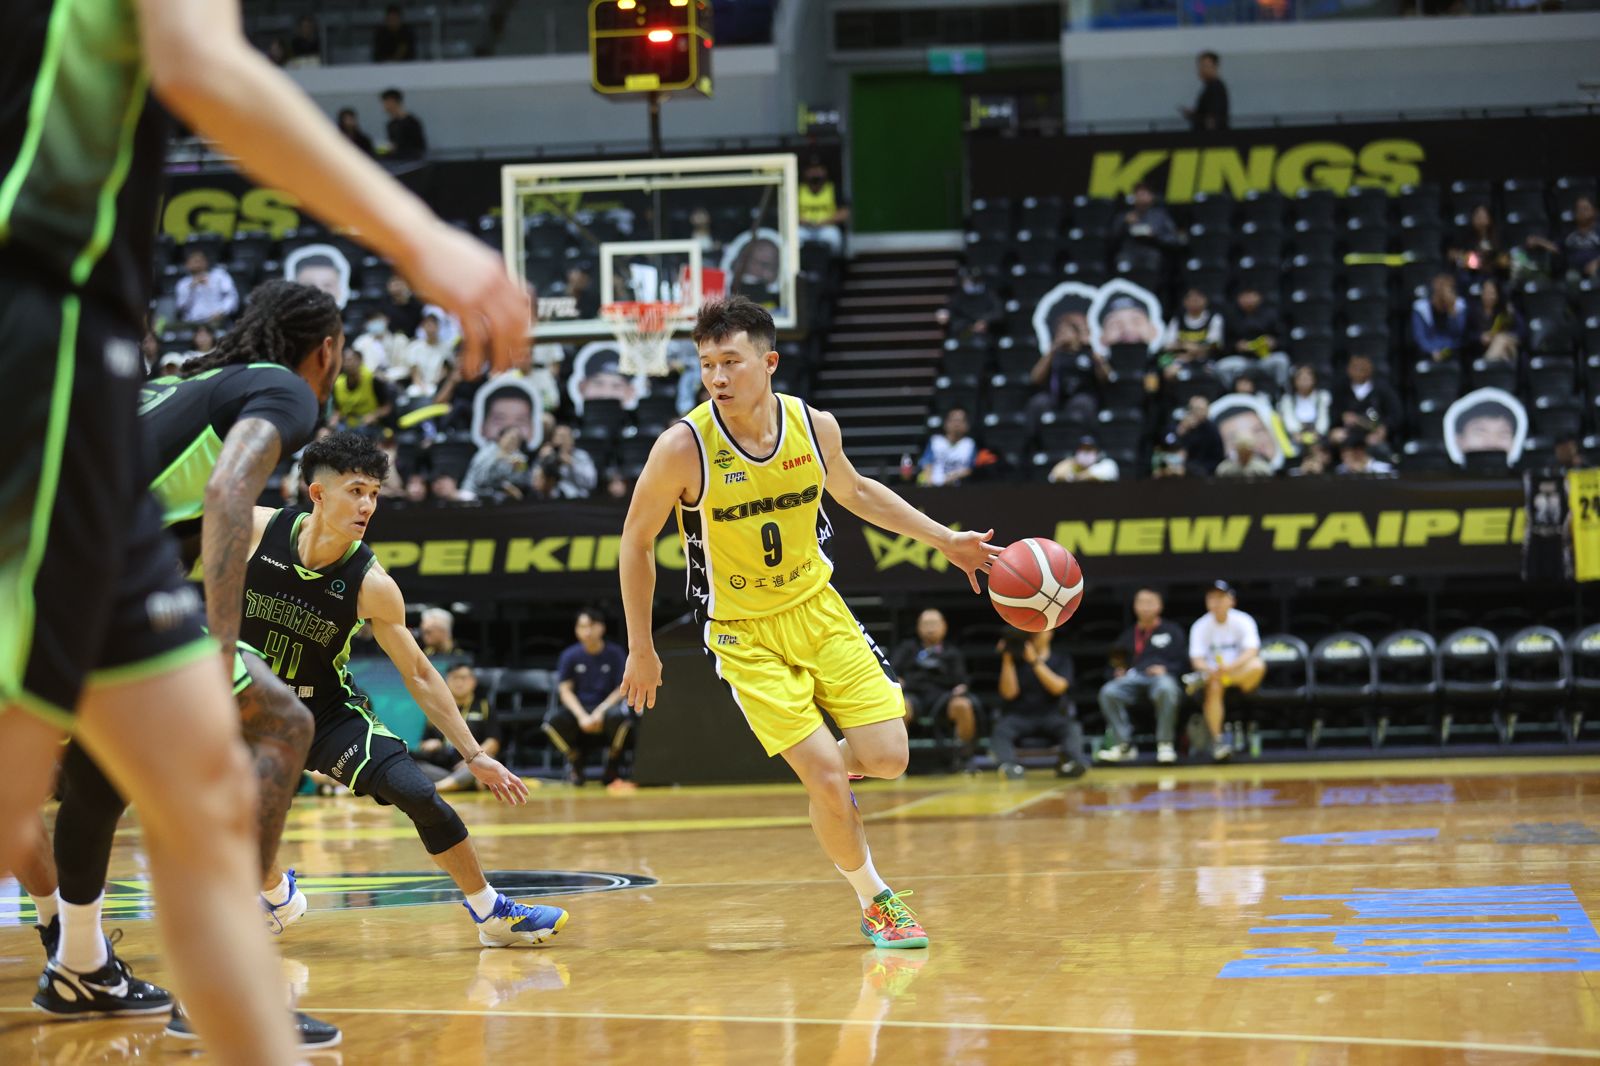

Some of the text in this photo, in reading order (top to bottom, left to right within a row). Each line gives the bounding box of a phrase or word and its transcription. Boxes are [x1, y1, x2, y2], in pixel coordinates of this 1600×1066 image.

[1088, 139, 1425, 204] KINGS
[157, 187, 300, 245] GS
[782, 453, 812, 471] SAMPO
[712, 485, 819, 522] KINGS
[761, 522, 783, 568] 9
[1054, 515, 1252, 556] NEW
[245, 588, 340, 648] DREAMERS
[264, 630, 304, 680] 41
